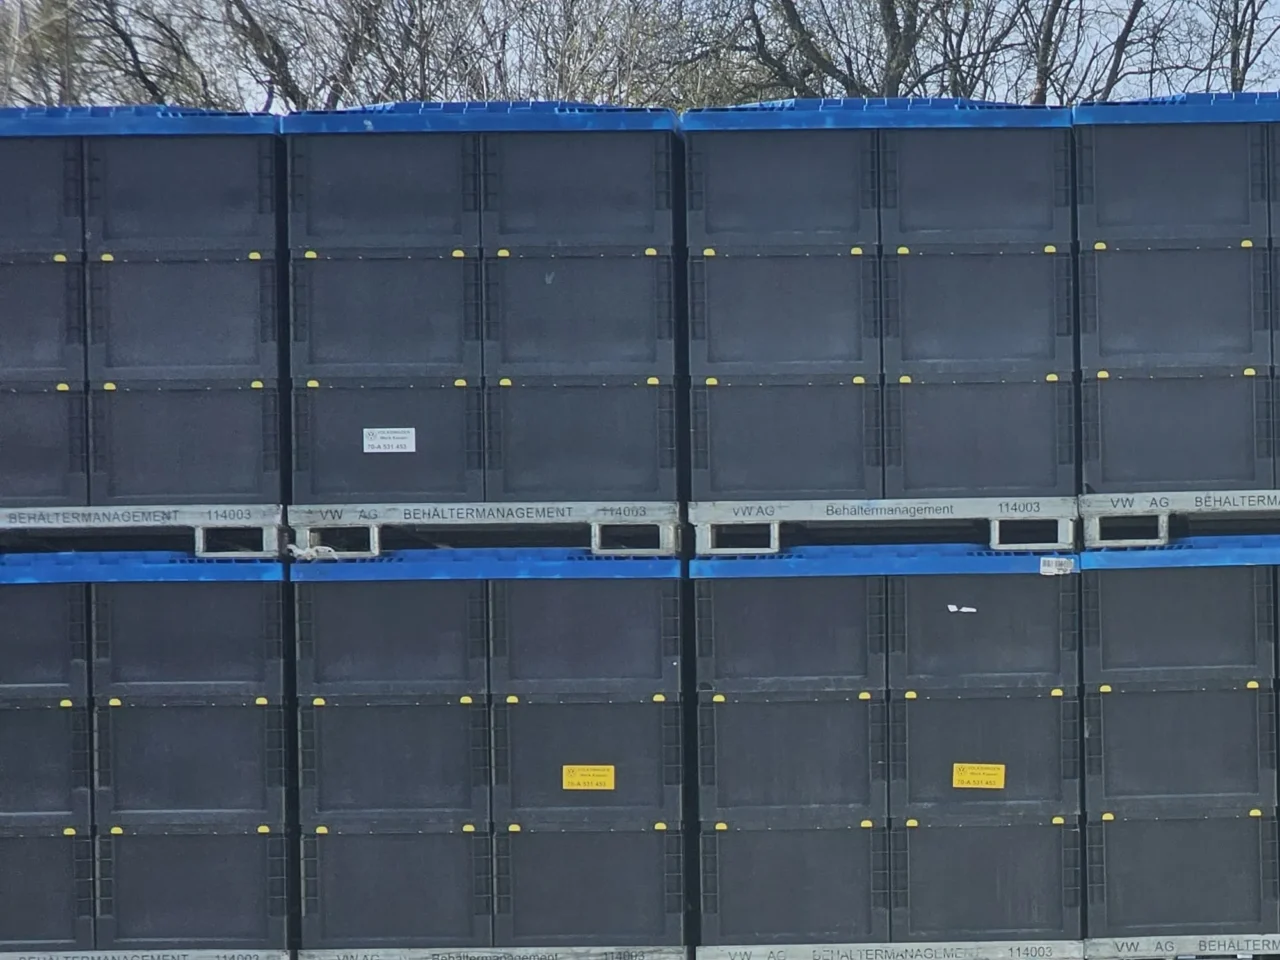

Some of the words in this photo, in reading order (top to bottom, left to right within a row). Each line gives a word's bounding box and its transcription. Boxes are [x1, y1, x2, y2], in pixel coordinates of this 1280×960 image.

[1110, 497, 1134, 508] VW
[1149, 497, 1170, 508] AG
[320, 509, 344, 520] VW
[732, 506, 753, 516] VW
[754, 505, 776, 516] AG
[998, 502, 1041, 513] 114003
[207, 509, 251, 521] 114003
[1115, 941, 1139, 952] VW
[1155, 941, 1175, 952] AG
[1008, 947, 1053, 958] 114003
